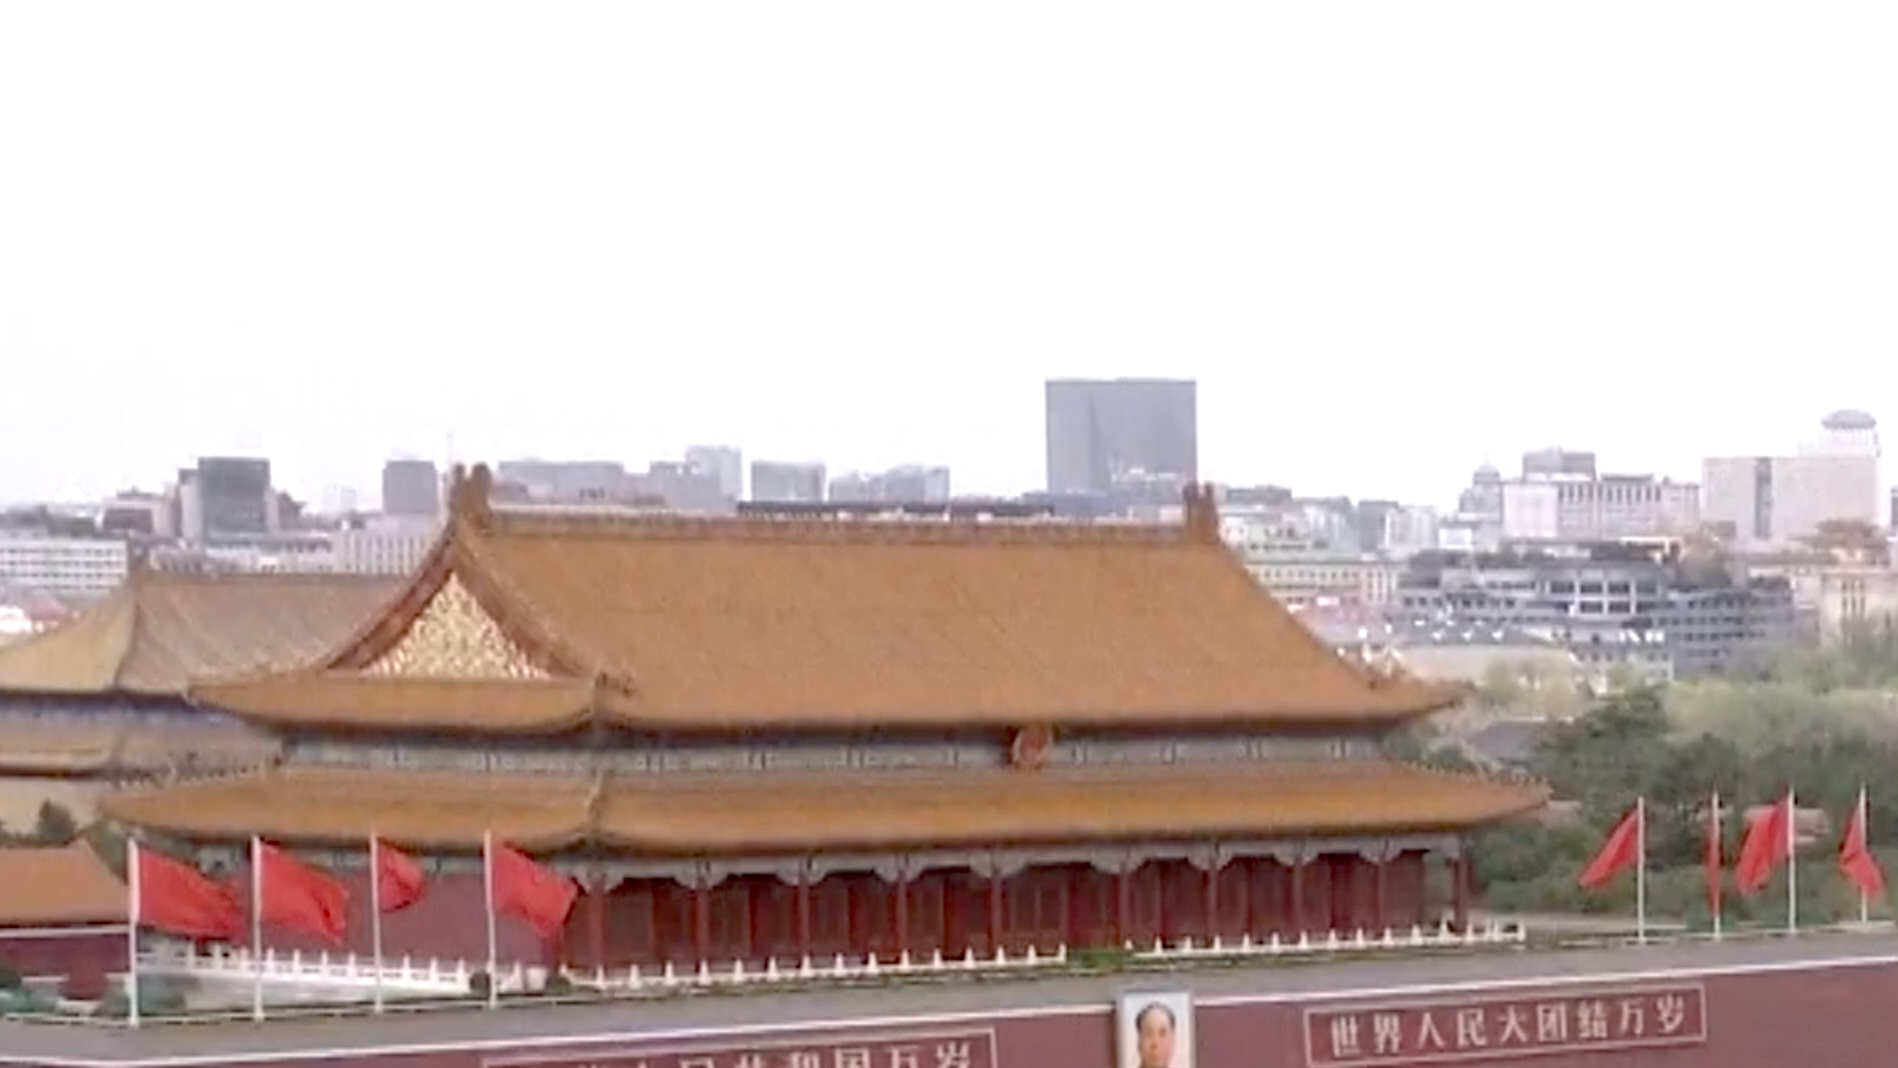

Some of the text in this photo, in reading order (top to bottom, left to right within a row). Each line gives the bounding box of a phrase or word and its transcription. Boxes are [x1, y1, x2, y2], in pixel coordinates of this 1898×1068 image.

[1331, 994, 1685, 1058] 世界人民大团结万岁
